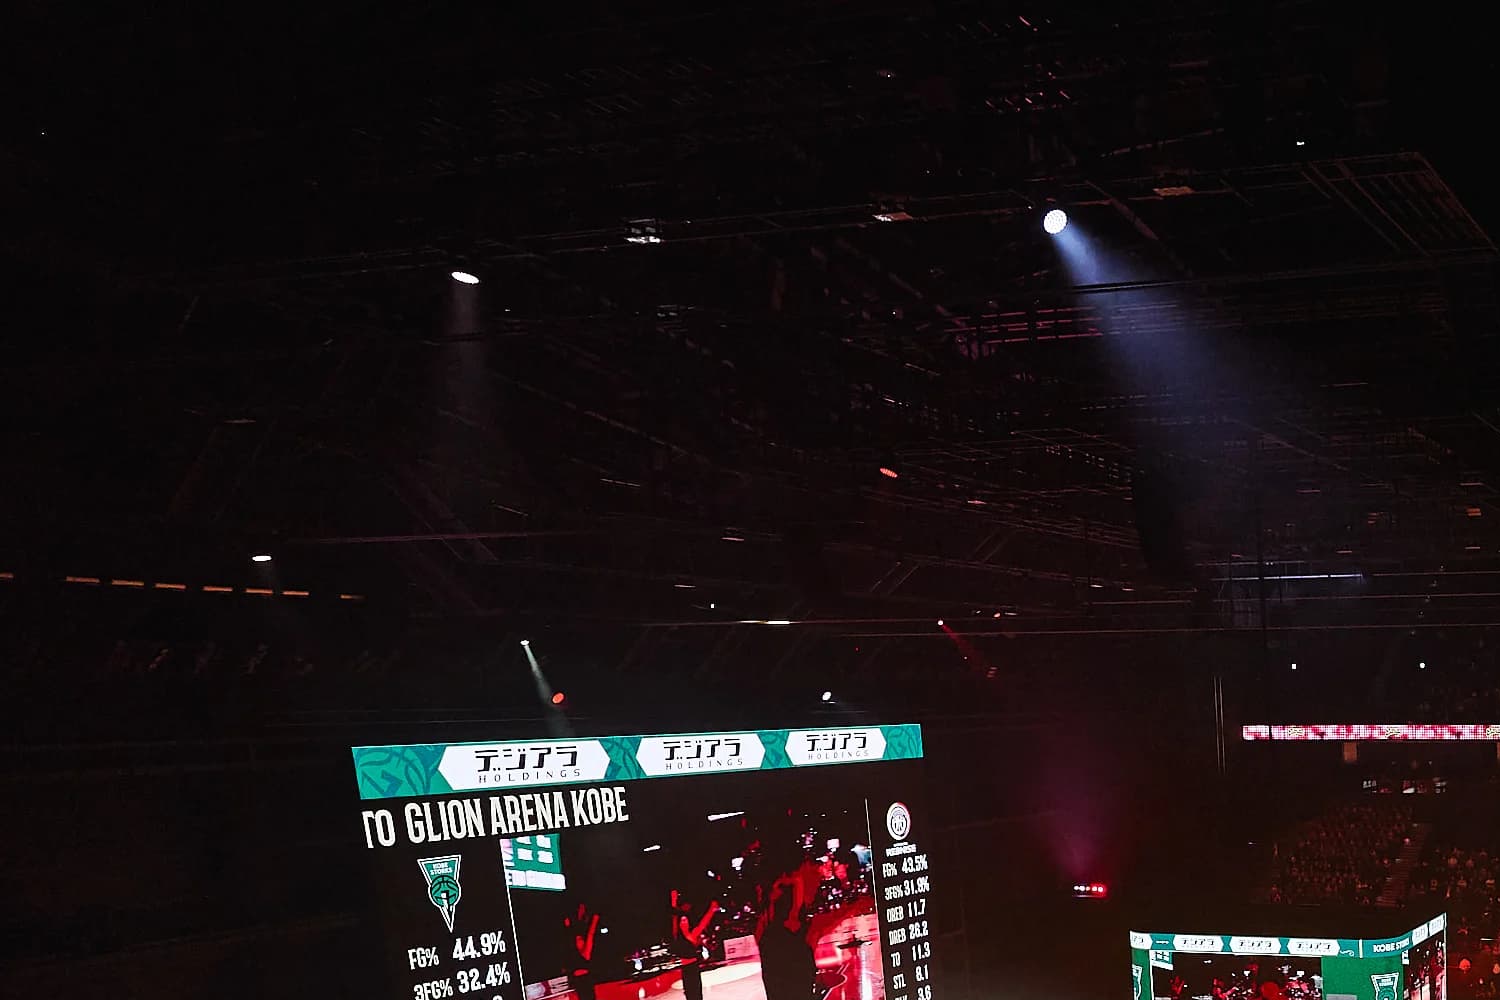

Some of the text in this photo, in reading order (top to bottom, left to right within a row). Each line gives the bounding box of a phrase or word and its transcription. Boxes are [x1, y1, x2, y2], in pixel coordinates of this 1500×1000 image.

[663, 738, 740, 760] デジアラ
[806, 733, 867, 751] デジアラ
[475, 746, 578, 772] デジアラ
[808, 749, 869, 760] HOLDINGS
[665, 758, 743, 770] HOLDINGS
[478, 768, 581, 783] HOLDINGS
[404, 798, 486, 844] GLION
[489, 791, 570, 836] ARENA
[567, 786, 629, 827] KOBE
[430, 867, 452, 876] STORKS
[432, 861, 448, 869] KOBE
[883, 862, 897, 878] FG%
[884, 884, 904, 900] 3FG%
[886, 906, 904, 923] OREB
[908, 898, 926, 918] 11.7
[889, 928, 906, 946] DREB
[908, 920, 928, 940] 26.2
[452, 930, 506, 960] 44.9%
[912, 941, 931, 961] 11.3
[1373, 943, 1396, 953] KOBE
[408, 946, 439, 970] FG%
[891, 952, 901, 967] TO
[456, 962, 511, 993] 32.4%
[893, 973, 906, 990] STL
[915, 964, 929, 982] 8.1
